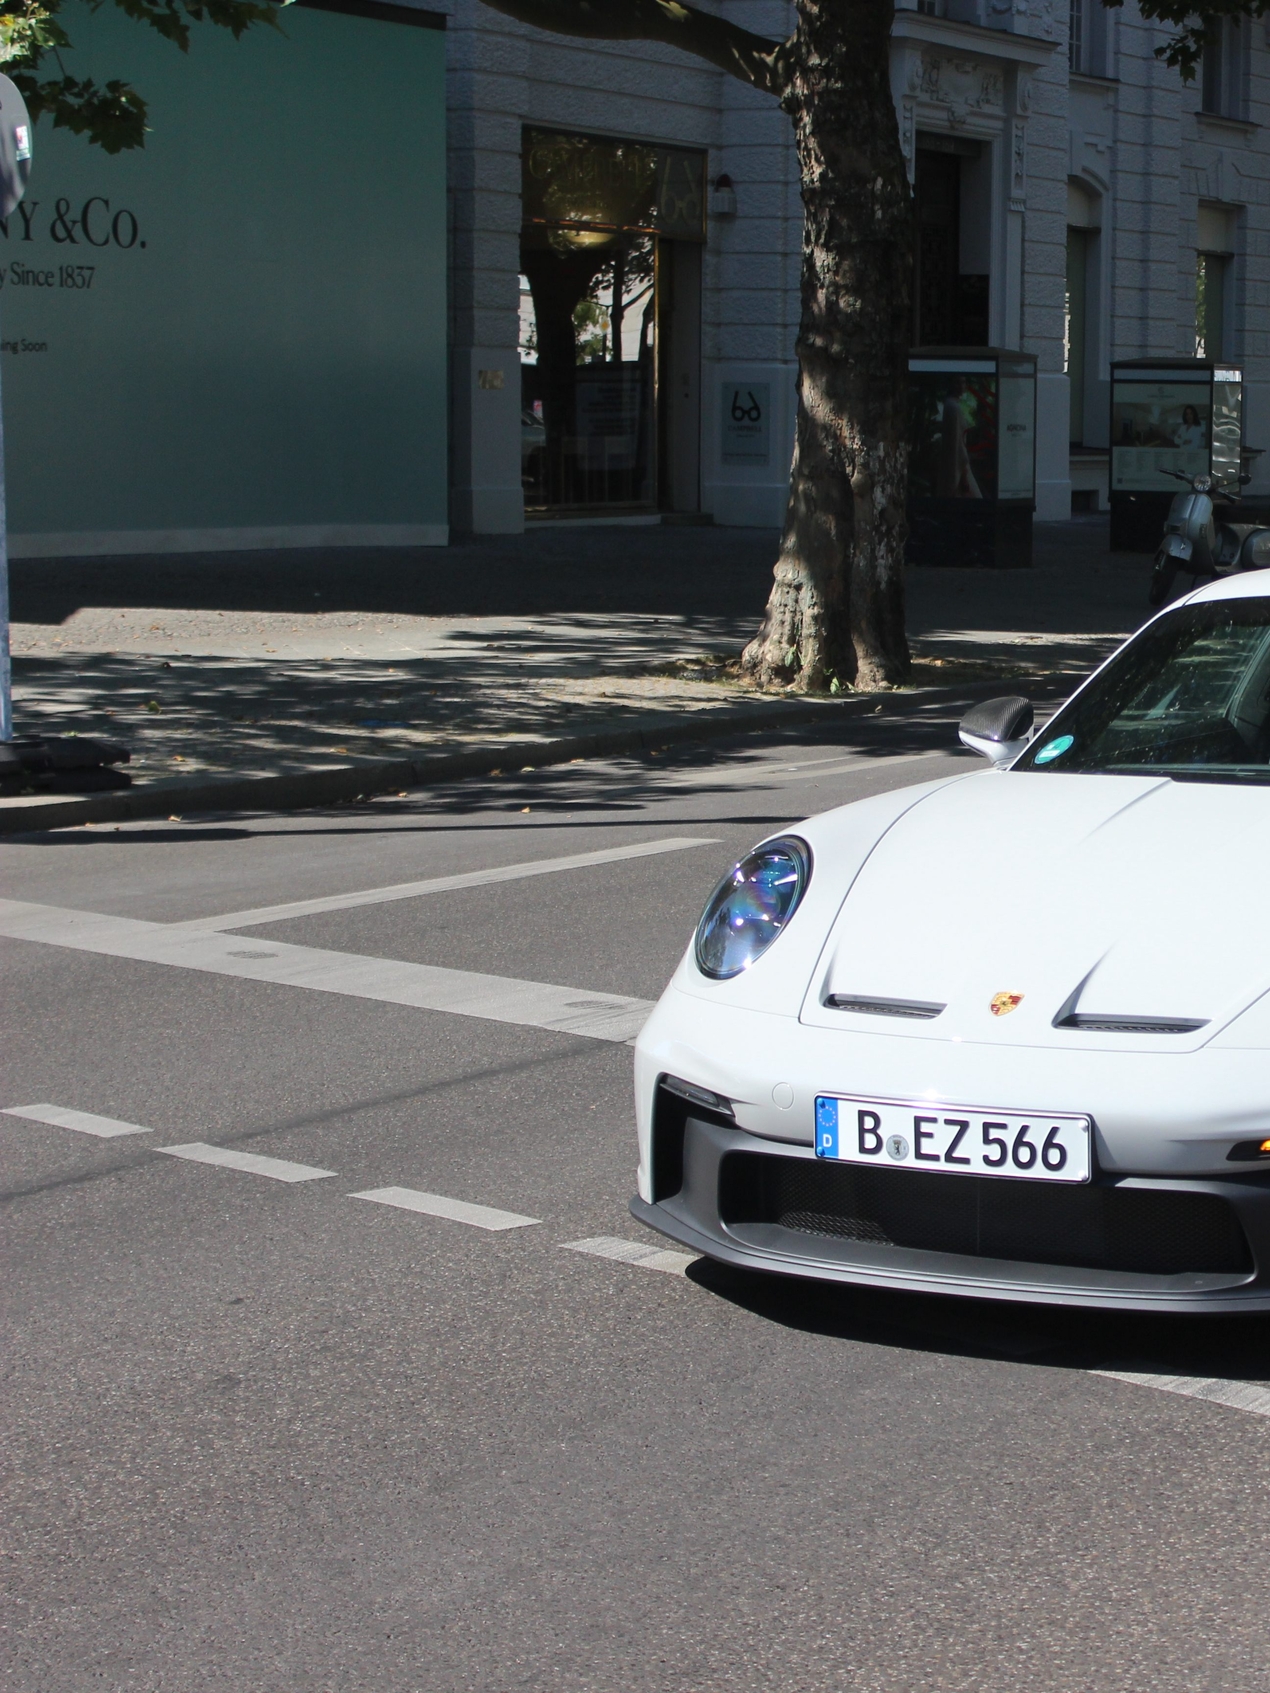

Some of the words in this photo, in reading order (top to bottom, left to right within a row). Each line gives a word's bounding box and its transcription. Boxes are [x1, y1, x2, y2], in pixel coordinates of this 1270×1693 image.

[10, 261, 54, 288] Since
[59, 265, 95, 289] 1837
[21, 339, 47, 352] Soon
[823, 1134, 832, 1148] D
[858, 1109, 883, 1155] B
